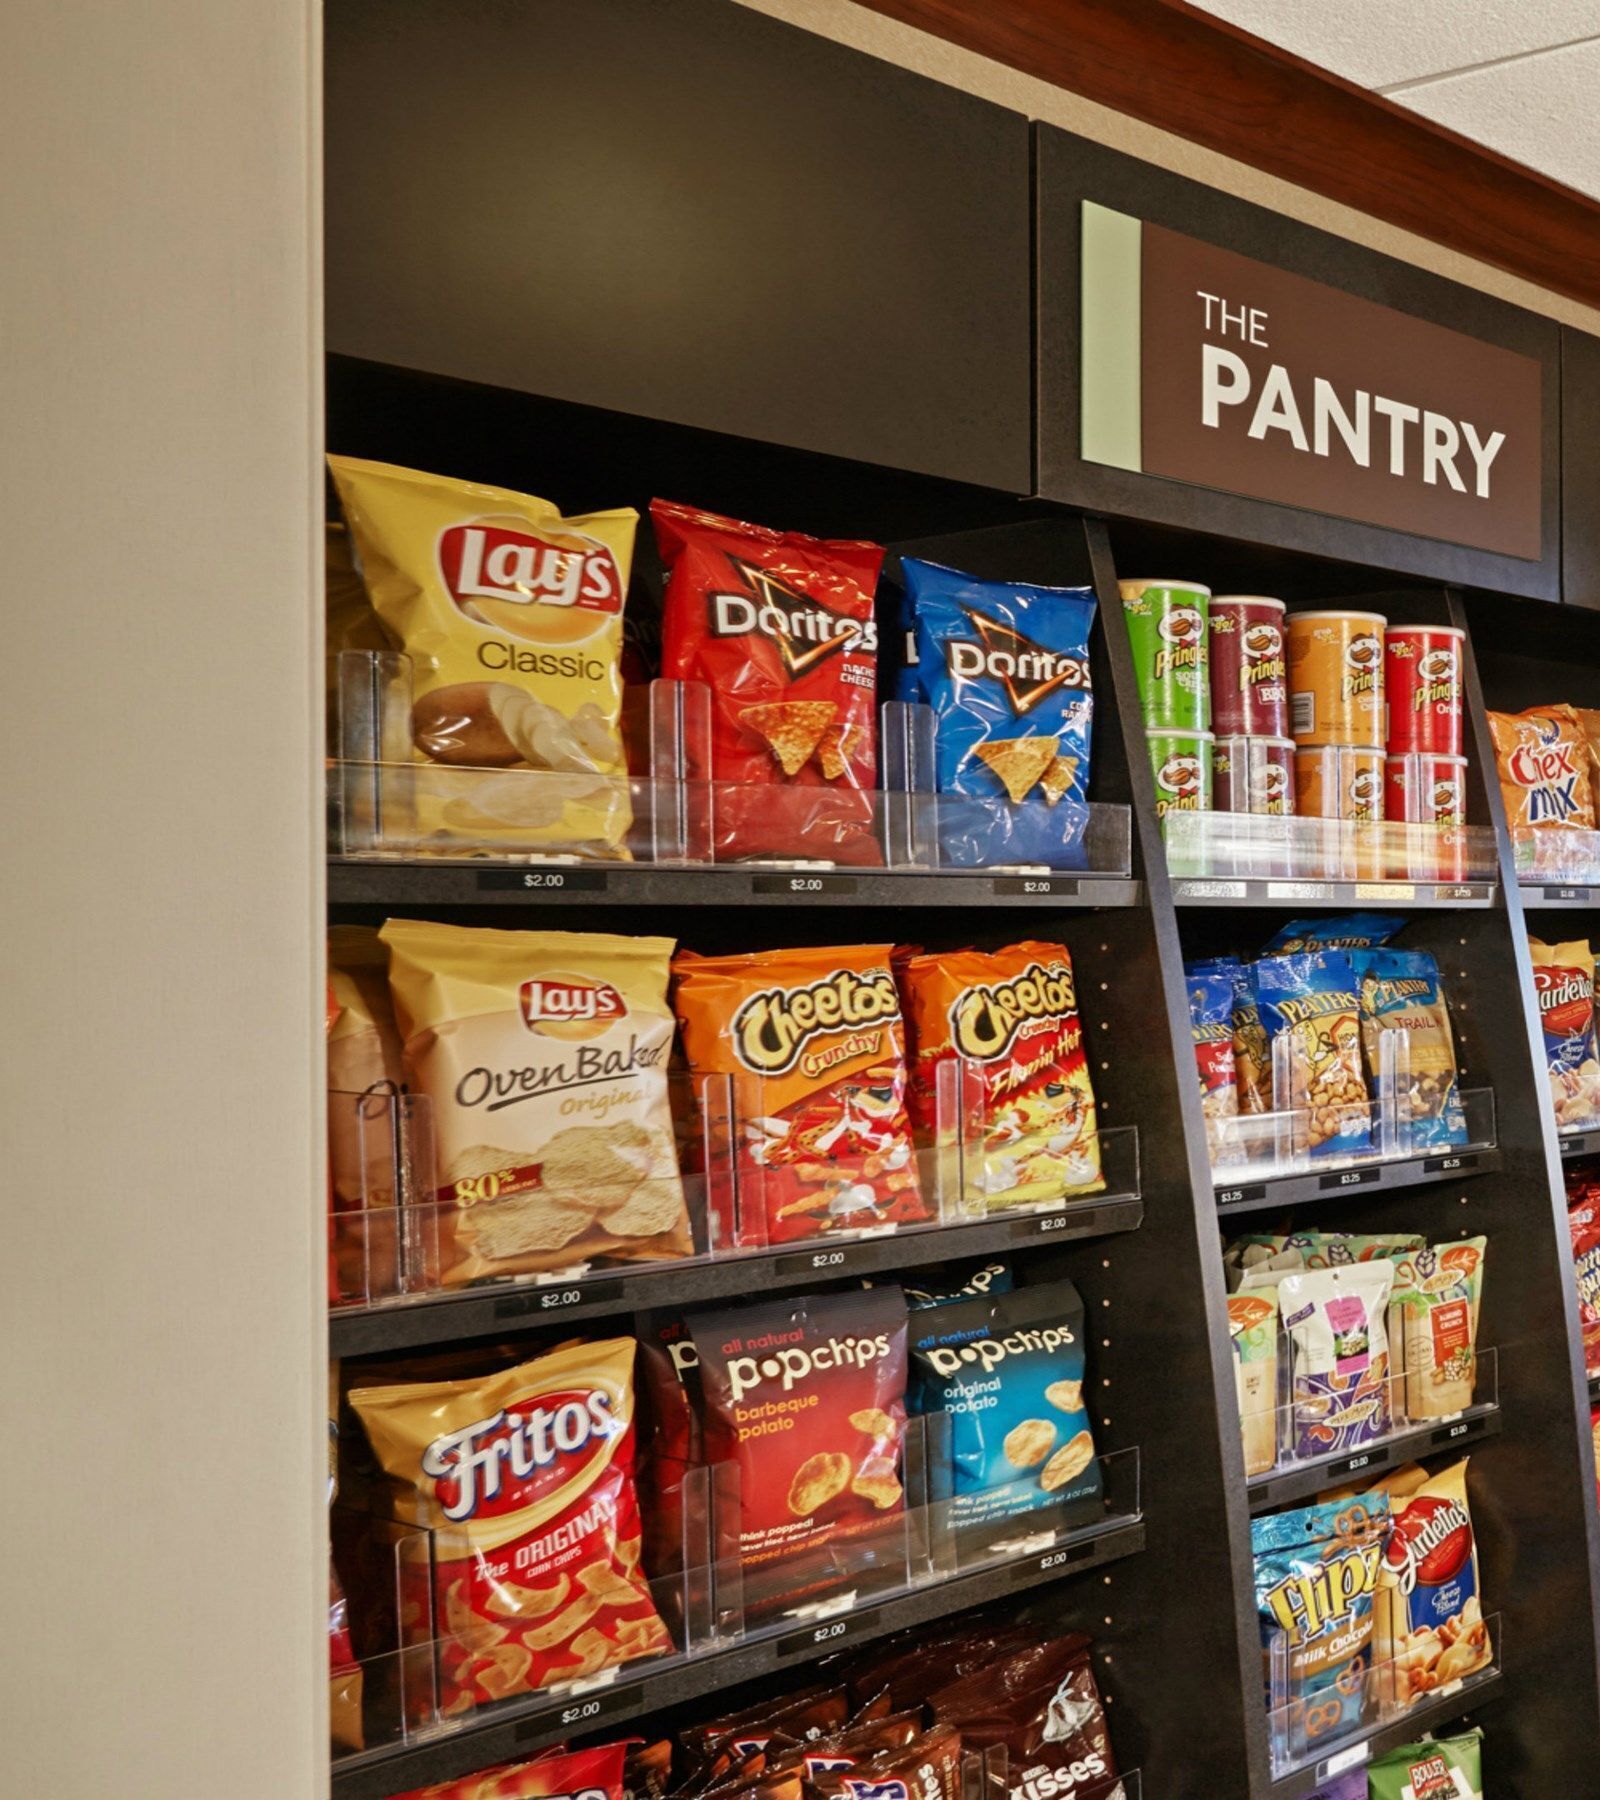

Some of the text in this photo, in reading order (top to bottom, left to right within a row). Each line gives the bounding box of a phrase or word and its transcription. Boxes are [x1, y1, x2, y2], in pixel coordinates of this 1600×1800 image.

[1197, 291, 1269, 348] THE
[1201, 343, 1506, 499] PANTRY
[456, 528, 614, 606] Lay's
[714, 592, 878, 652] Doritos
[476, 641, 605, 682] Classic
[1510, 745, 1575, 784] Chex
[524, 874, 564, 888] $2.00
[789, 879, 823, 892] $2.00
[1023, 881, 1051, 893] $2.00
[527, 983, 618, 1022] Lay's
[956, 967, 1076, 1057] Cheetos
[738, 973, 898, 1068] Cheetos
[800, 1031, 881, 1076] Crunchy
[1056, 1027, 1082, 1057] Hot
[1040, 1216, 1067, 1231] $2.00
[812, 1252, 844, 1267] $2.00
[541, 1290, 581, 1309] $2.00
[721, 1327, 804, 1355] all natural
[917, 1325, 992, 1348] all natural
[926, 1325, 1075, 1379] popchips
[727, 1331, 891, 1406] popchips
[943, 1375, 1002, 1400] original
[734, 1392, 819, 1423] barbeque
[944, 1396, 999, 1414] potato
[738, 1416, 795, 1443] potato
[423, 1389, 614, 1521] Fritos
[514, 1499, 617, 1570] ORIGINAL
[1040, 1552, 1067, 1569] $2.00
[813, 1622, 846, 1642] $2.00
[1293, 1646, 1327, 1667] Milk
[562, 1701, 600, 1723] $2.00
